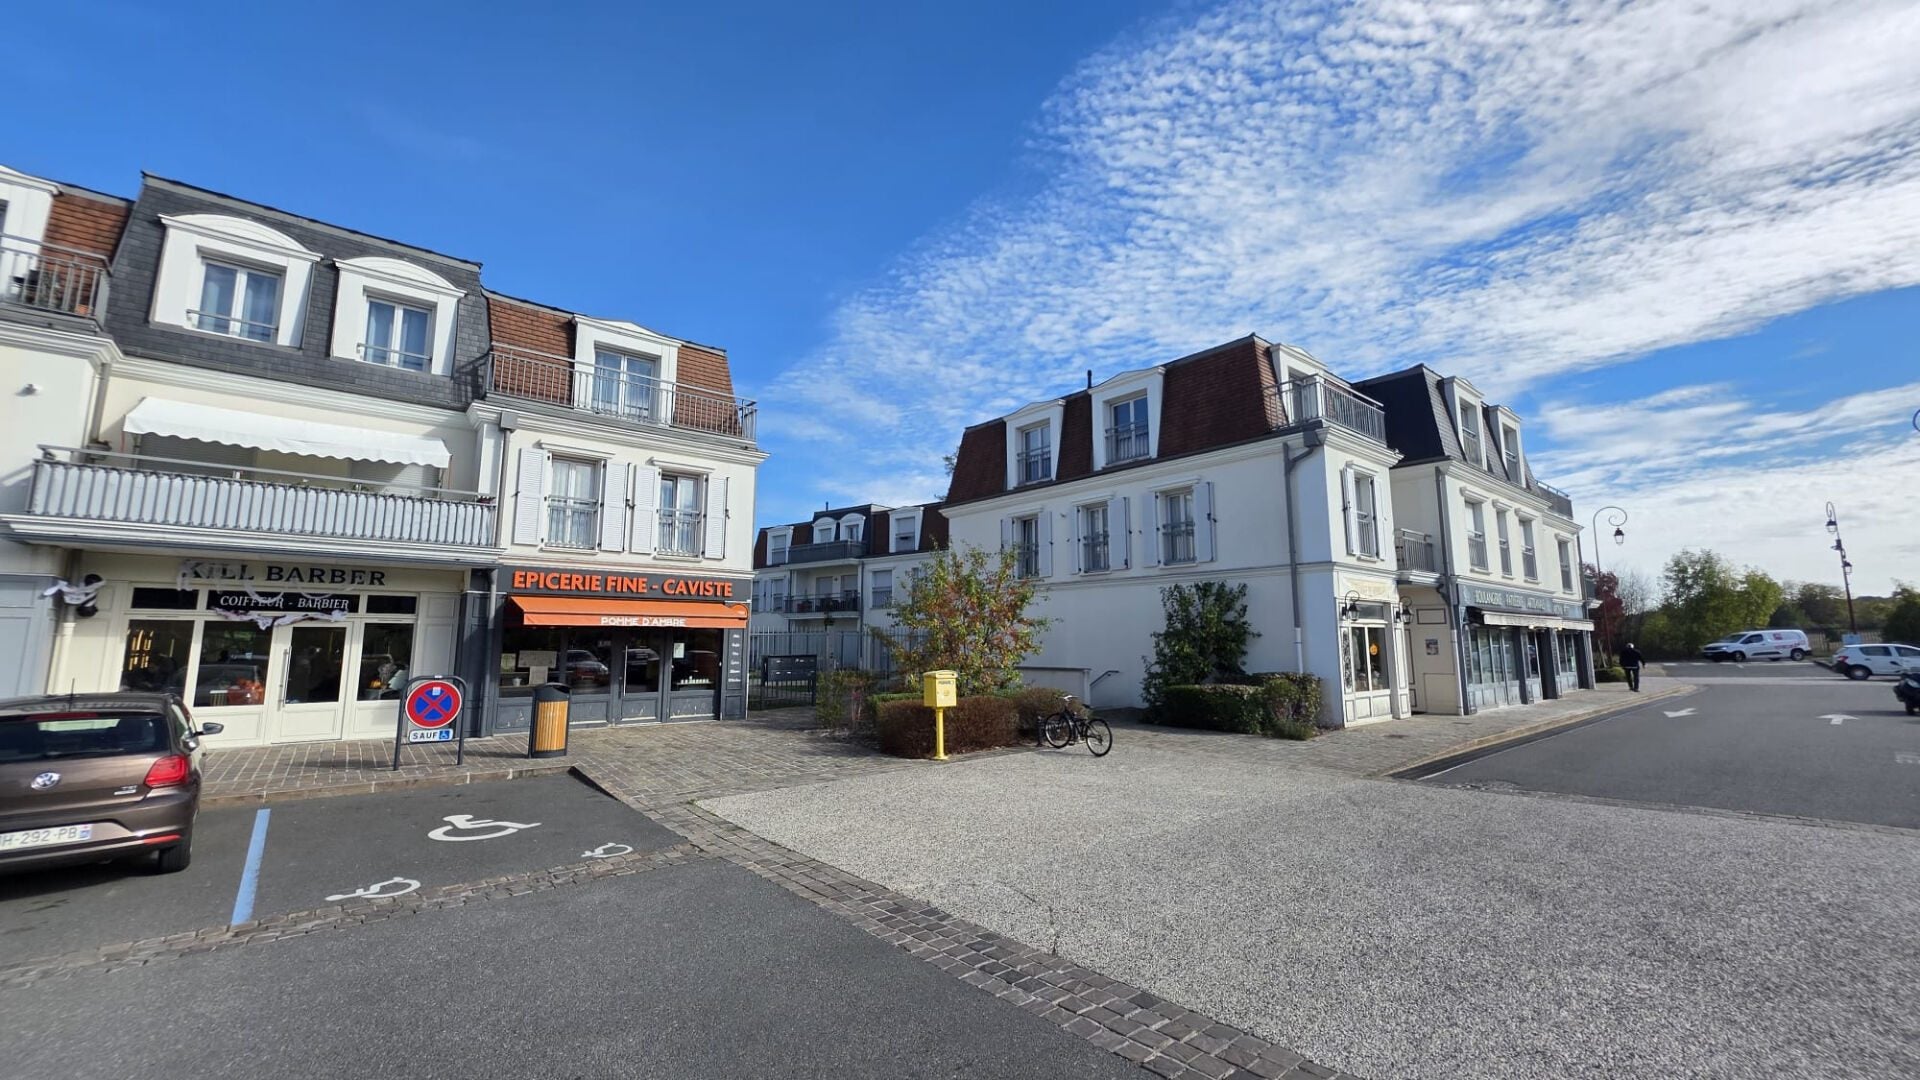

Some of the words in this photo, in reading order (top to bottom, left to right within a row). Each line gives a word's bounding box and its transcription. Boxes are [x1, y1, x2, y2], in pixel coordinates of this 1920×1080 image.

[265, 565, 386, 586] BARBER
[513, 570, 602, 592] EPICERIE
[606, 575, 648, 593] FINE
[663, 578, 733, 597] CAVISTE
[220, 596, 284, 609] COIFFEUR
[297, 598, 349, 611] BARBIER
[600, 616, 639, 626] POMME
[642, 617, 687, 627] D'AMBRE
[412, 731, 438, 740] SAUF
